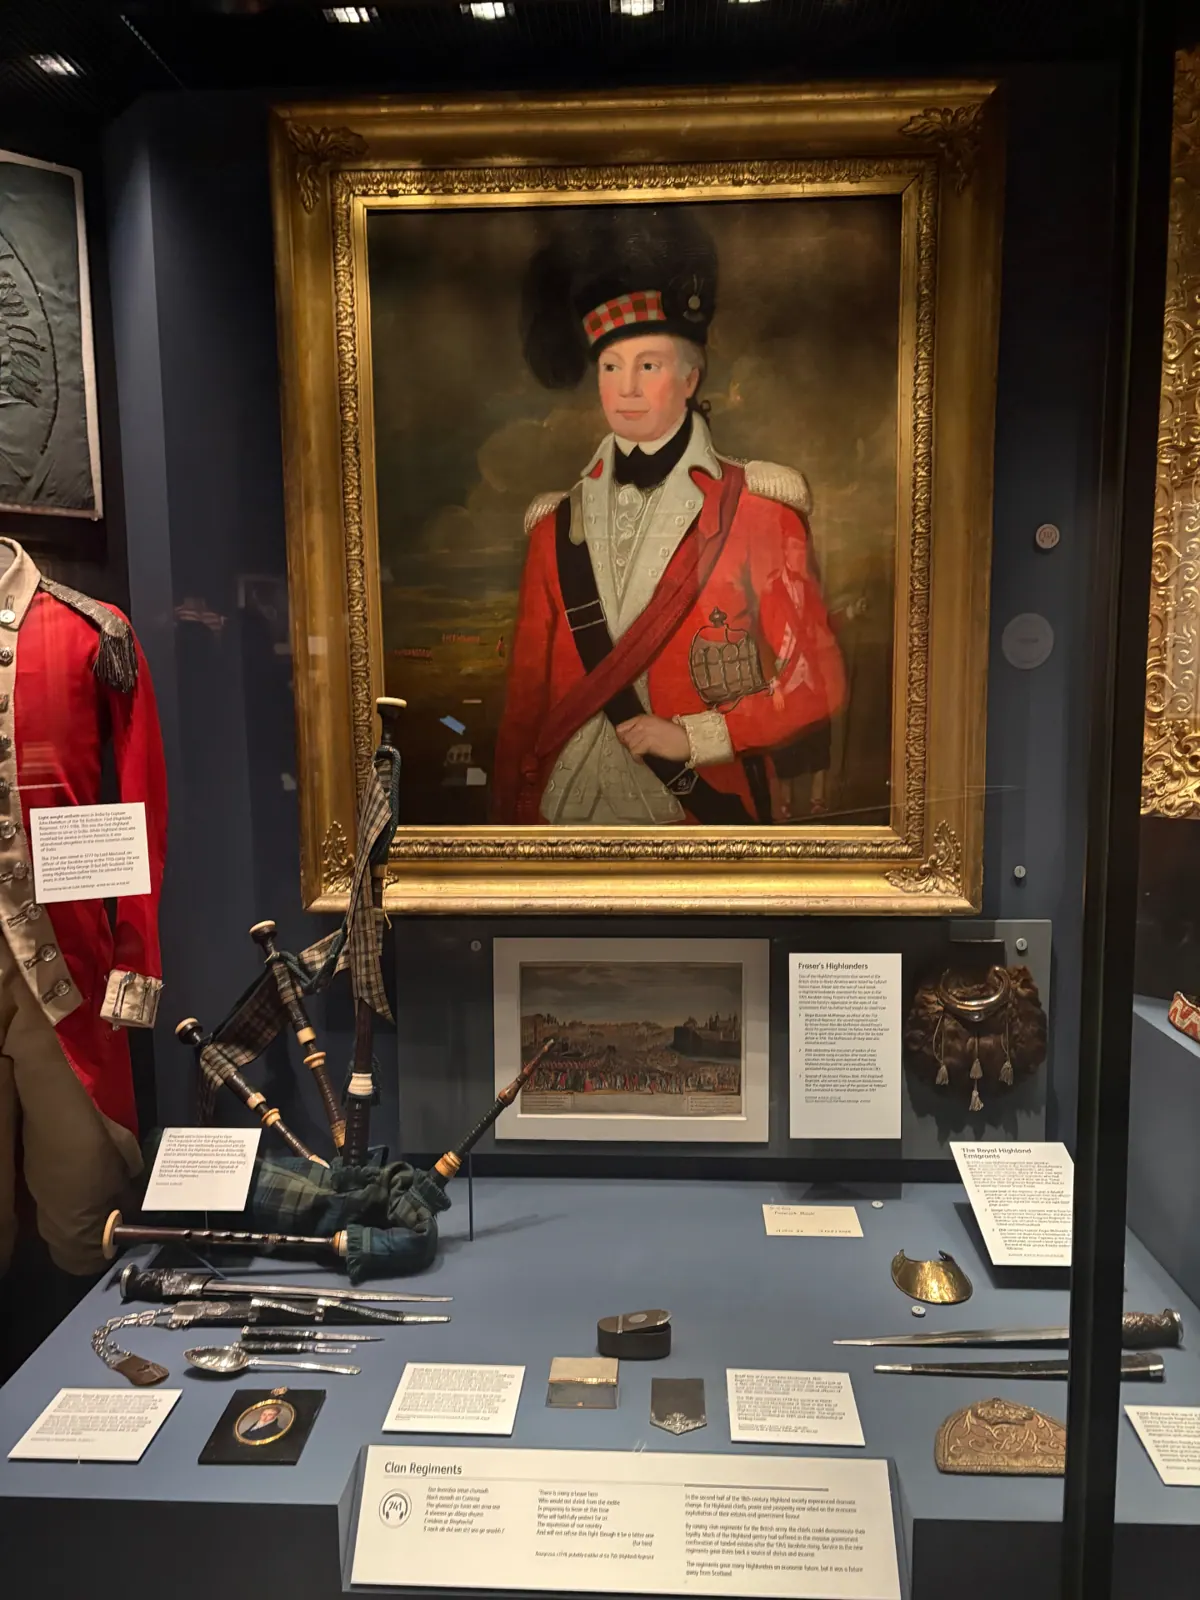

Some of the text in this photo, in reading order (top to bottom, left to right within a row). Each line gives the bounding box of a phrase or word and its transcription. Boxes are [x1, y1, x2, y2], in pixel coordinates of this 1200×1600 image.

[798, 962, 869, 972] Fraser's Highlanders
[384, 1461, 463, 1477] Clan Regiments
[770, 1497, 790, 1505] Highland
[711, 1503, 732, 1511] Highland
[757, 1512, 784, 1520] government
[685, 1523, 692, 1531] By
[730, 1532, 752, 1540] Highland
[745, 1562, 773, 1571] Highlanders
